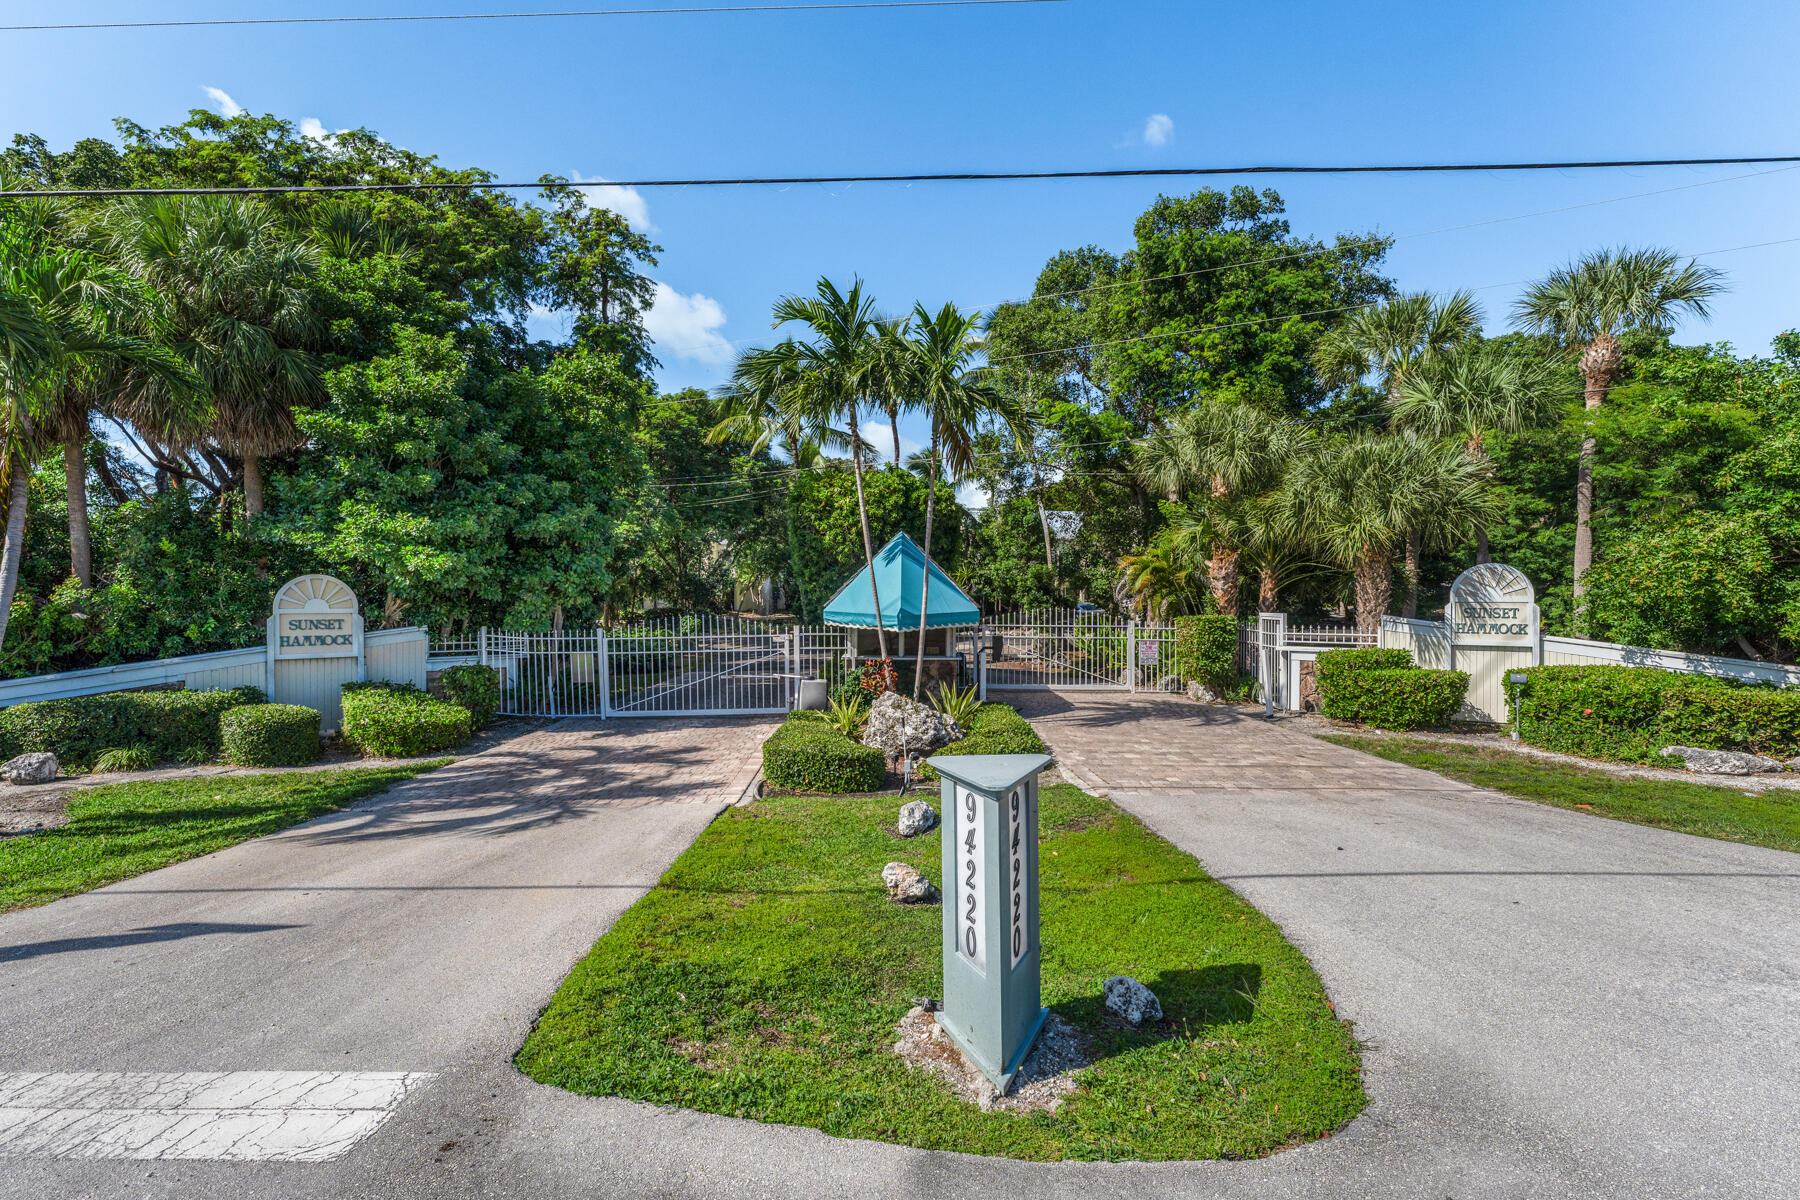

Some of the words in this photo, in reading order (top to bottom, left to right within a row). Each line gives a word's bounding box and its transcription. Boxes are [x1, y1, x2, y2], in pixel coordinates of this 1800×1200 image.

[1464, 607, 1519, 619] SUNSET
[289, 619, 344, 630] SUNSET
[1455, 623, 1528, 635] HAMMOCK
[280, 634, 352, 647] HAMMOCK
[965, 791, 977, 958] 94220
[1011, 790, 1021, 958] 94220
